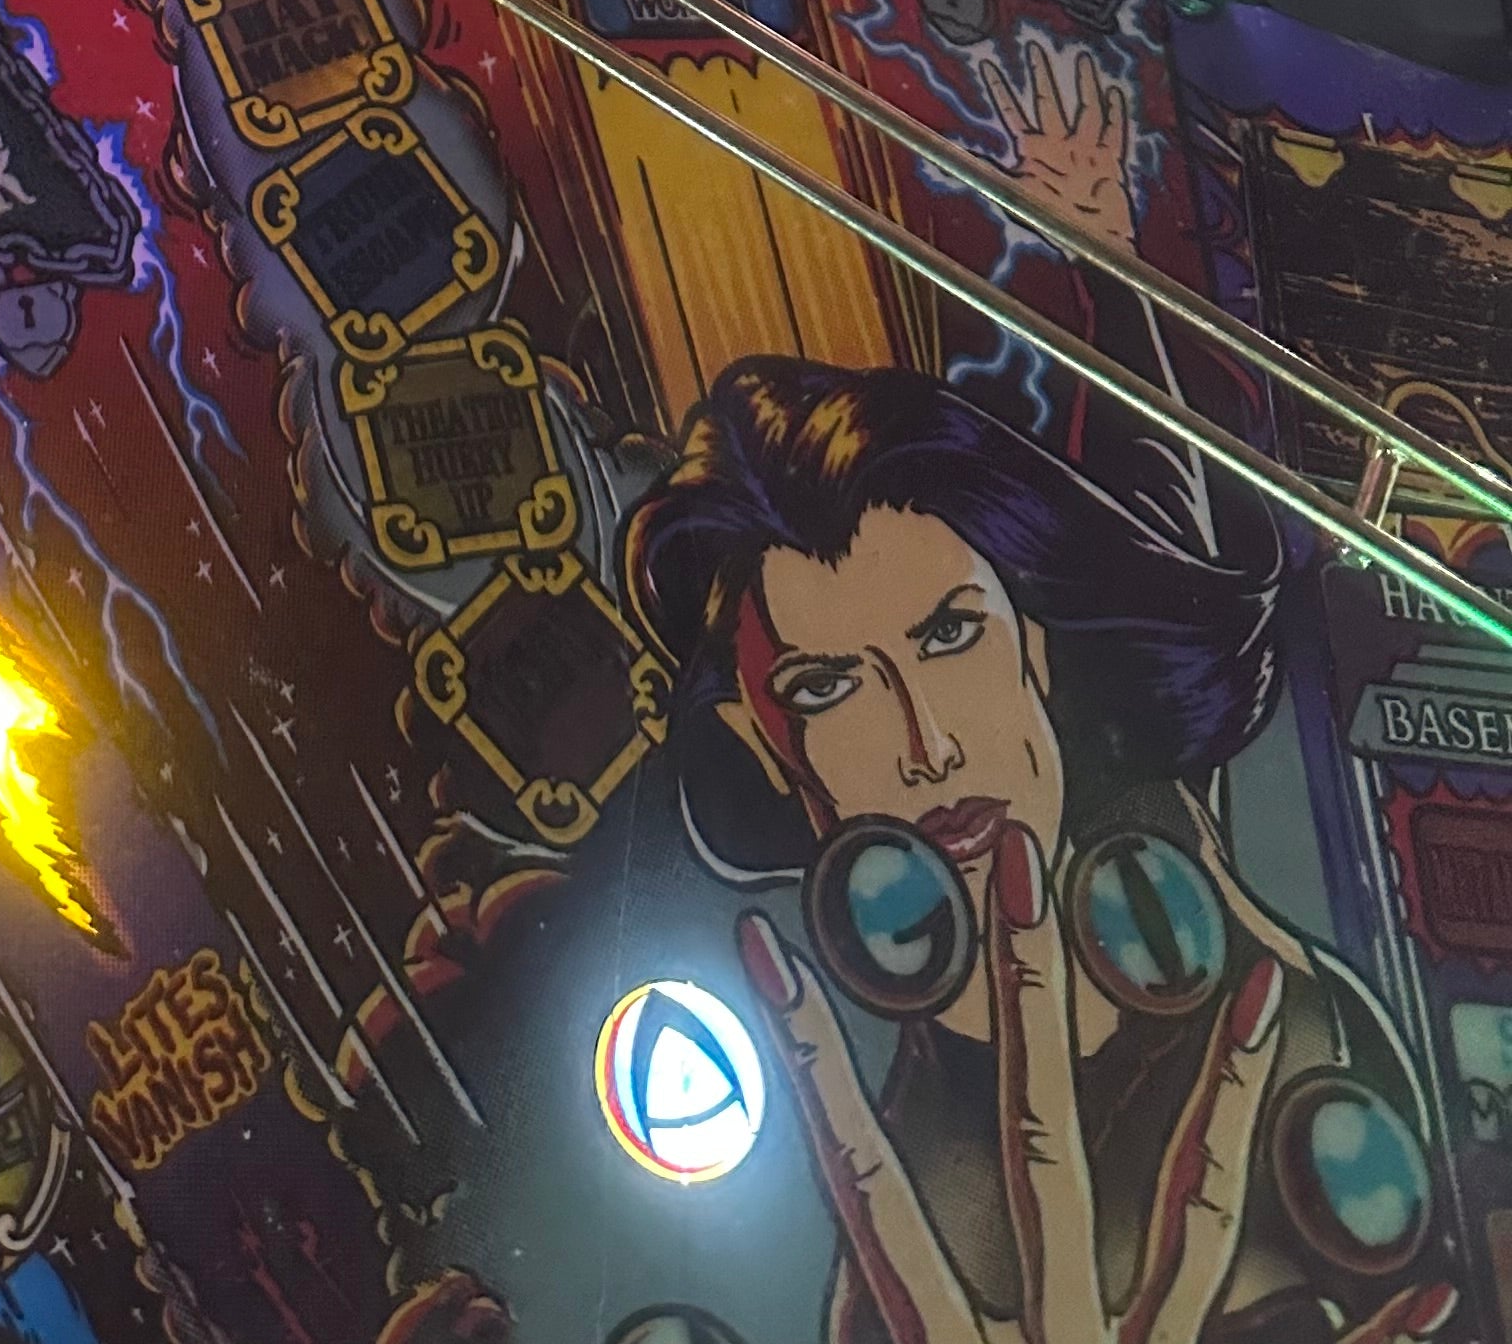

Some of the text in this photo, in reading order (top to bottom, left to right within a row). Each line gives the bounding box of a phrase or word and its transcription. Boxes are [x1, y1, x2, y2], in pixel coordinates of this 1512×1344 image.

[1383, 698, 1512, 753] BASE
[89, 951, 231, 1093] LITES
[94, 995, 267, 1164] VANISH
